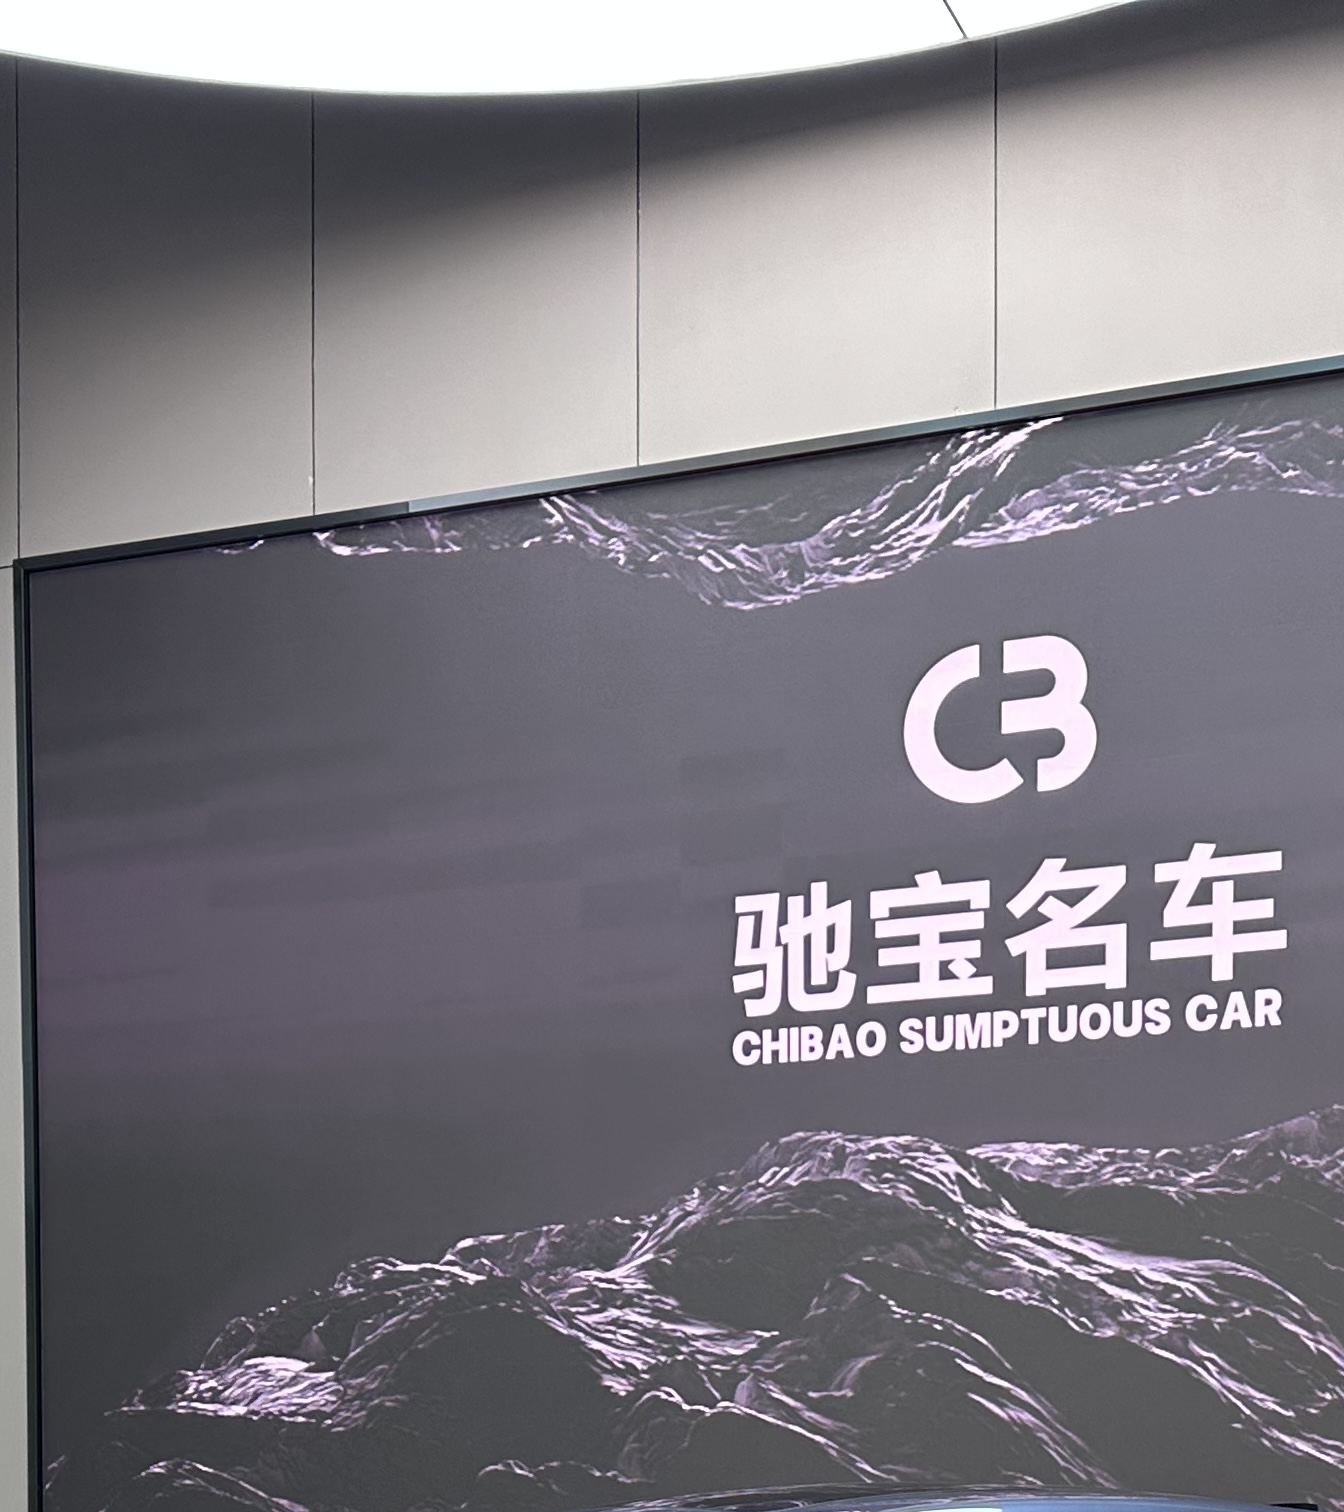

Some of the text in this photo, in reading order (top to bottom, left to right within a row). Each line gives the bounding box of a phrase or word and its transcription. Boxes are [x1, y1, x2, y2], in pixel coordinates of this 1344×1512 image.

[732, 842, 1288, 1018] 驰宝名车
[732, 988, 1282, 1066] CHIBAO SUMPTUOUS CAR
